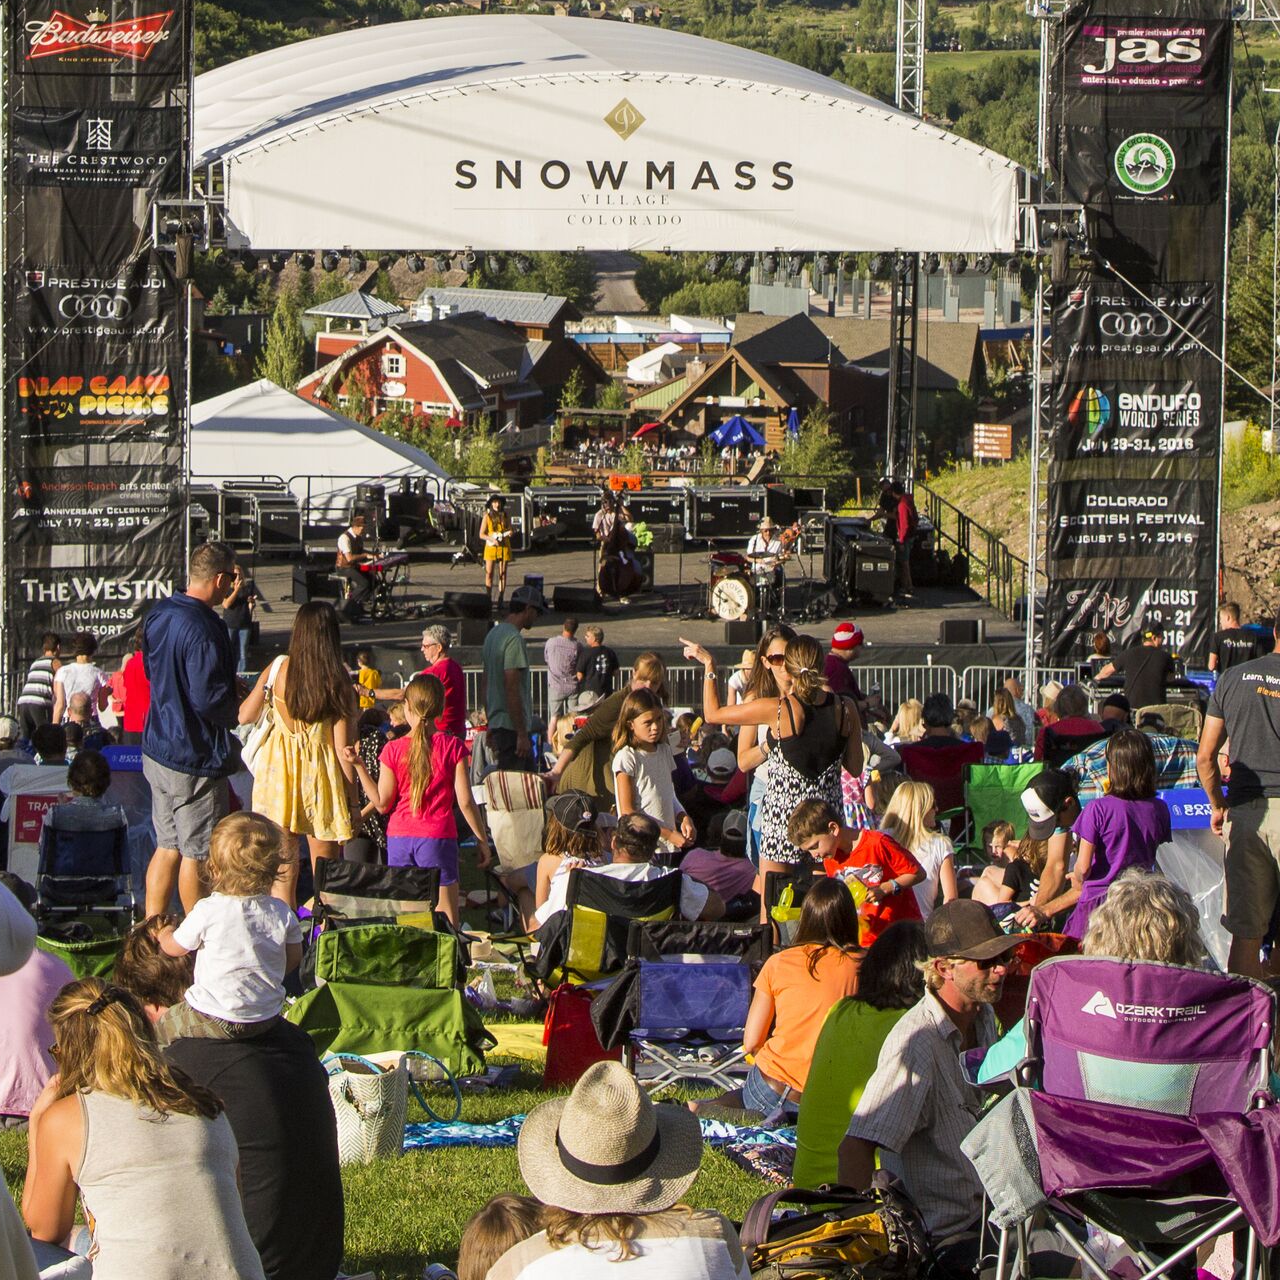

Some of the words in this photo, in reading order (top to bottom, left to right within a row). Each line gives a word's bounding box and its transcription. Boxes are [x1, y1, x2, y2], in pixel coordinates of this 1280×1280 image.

[25, 20, 170, 46] Budweiser
[1084, 37, 1202, 74] jas
[1129, 76, 1160, 85] educate
[1118, 148, 1126, 169] HOLY
[1126, 135, 1153, 149] CROSS
[1154, 139, 1174, 170] ENERGY
[27, 153, 60, 165] THE
[67, 155, 167, 166] CRESTWOOD
[454, 160, 795, 191] SNOWMASS
[580, 193, 670, 206] VILLAGE
[567, 214, 682, 226] COLORADO
[48, 278, 126, 289] PRESTIGE
[129, 278, 166, 289] AUDI
[1170, 296, 1206, 307] AUDI
[90, 375, 170, 396] CAMP
[79, 395, 169, 416] PICNIC
[1120, 409, 1158, 428] WORLD
[1163, 410, 1200, 428] SERIES
[1082, 437, 1109, 453] July
[1158, 437, 1194, 451] 2016
[120, 482, 138, 490] arts
[140, 482, 171, 491] center
[1086, 495, 1168, 507] COLORADO
[43, 507, 104, 516] ANNIVERSARY
[38, 519, 62, 528] JULY
[67, 519, 81, 528] 17
[93, 518, 114, 530] 22,
[117, 517, 150, 527] 2016
[1060, 514, 1130, 527] SCOTTISH
[1136, 513, 1205, 526] FESTIVAL
[1067, 534, 1113, 544] AUGUST
[1118, 533, 1126, 543] 5
[1139, 533, 1152, 544] 7,
[1157, 532, 1193, 543] 2016
[21, 579, 70, 602] THE
[72, 577, 173, 601] WESTIN
[1140, 589, 1198, 606] AUGUST
[65, 608, 134, 621] SNOWMASS
[1175, 609, 1191, 626] 21
[1242, 672, 1264, 681] Learn.
[1115, 1003, 1165, 1017] OZARK
